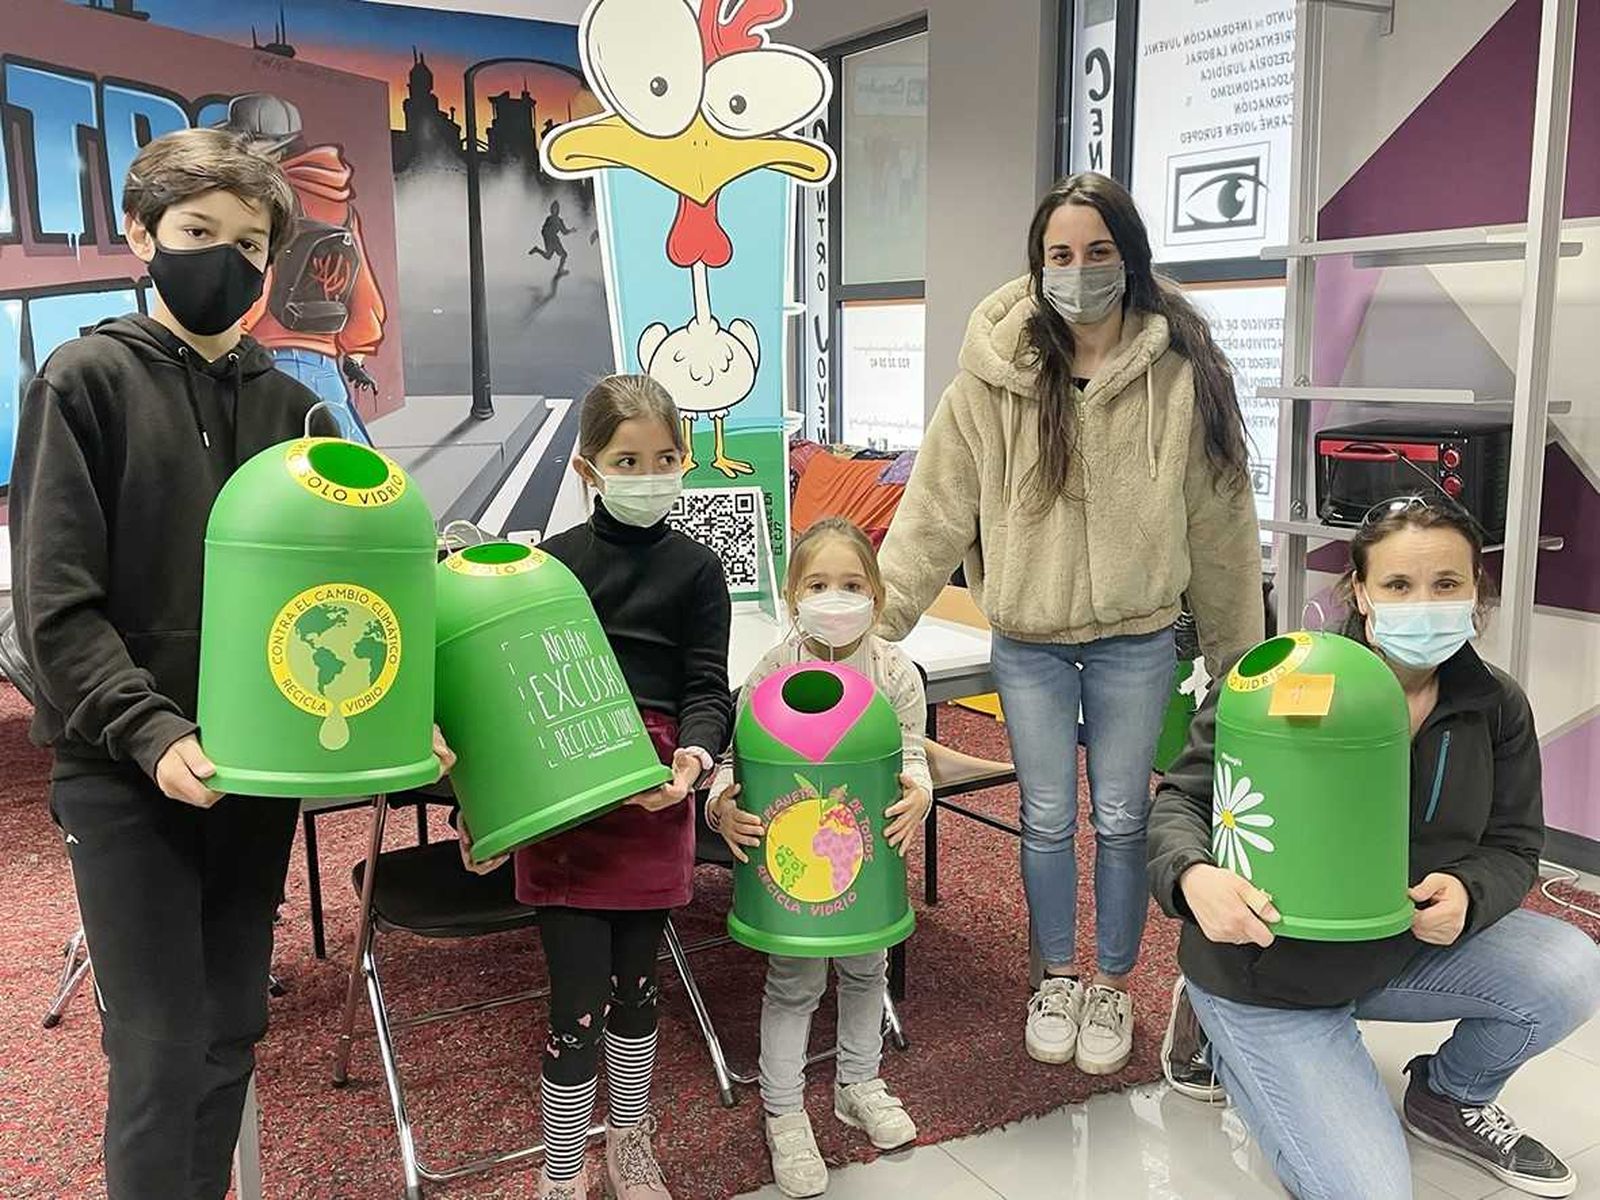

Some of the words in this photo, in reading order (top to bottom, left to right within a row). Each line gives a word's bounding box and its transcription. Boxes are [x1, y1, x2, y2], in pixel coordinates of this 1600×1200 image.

[358, 473, 403, 505] VIDRIO
[272, 611, 296, 665] CONTRA
[295, 596, 313, 612] EL
[313, 588, 370, 604] CAMBIO
[540, 630, 571, 665] NO
[563, 627, 593, 660] HAY
[281, 677, 328, 713] RECICLA
[344, 685, 382, 712] VIDRIO
[529, 655, 624, 720] EXCUSAS
[554, 715, 611, 759] RECICLA
